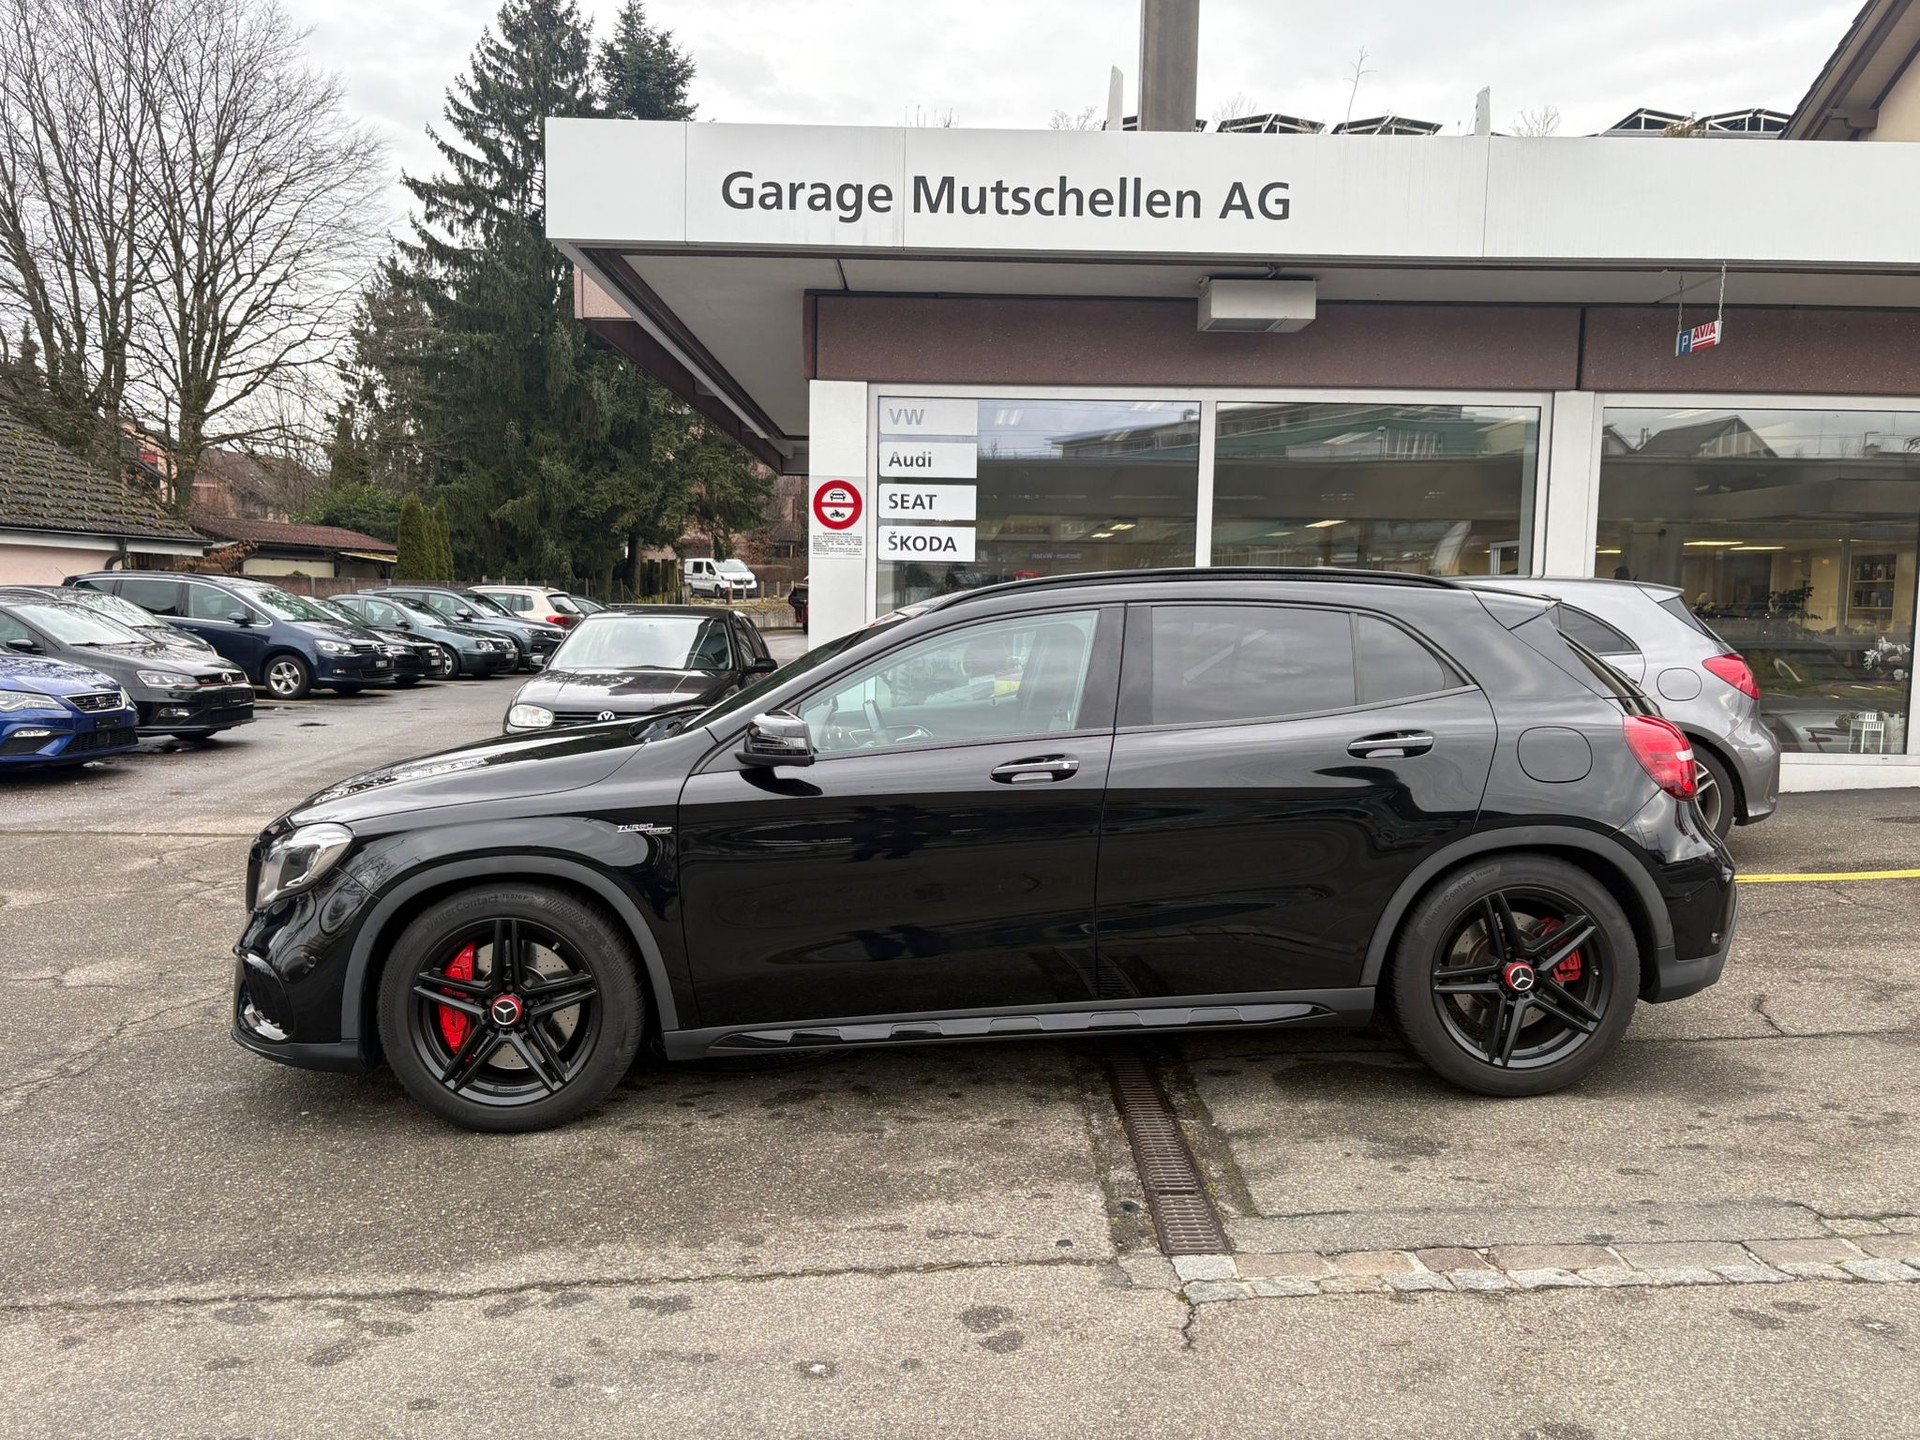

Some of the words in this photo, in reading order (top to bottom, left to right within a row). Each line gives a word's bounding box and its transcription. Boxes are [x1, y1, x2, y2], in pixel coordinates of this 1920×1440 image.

[721, 170, 894, 224] Garage
[912, 174, 1202, 219] Mutschellen
[1218, 180, 1292, 221] AG
[1681, 335, 1689, 352] P
[1692, 322, 1716, 341] AVIA
[888, 408, 925, 426] VW
[888, 451, 932, 468] Audi
[888, 493, 937, 510] SEAT
[888, 531, 957, 552] ŠKODA
